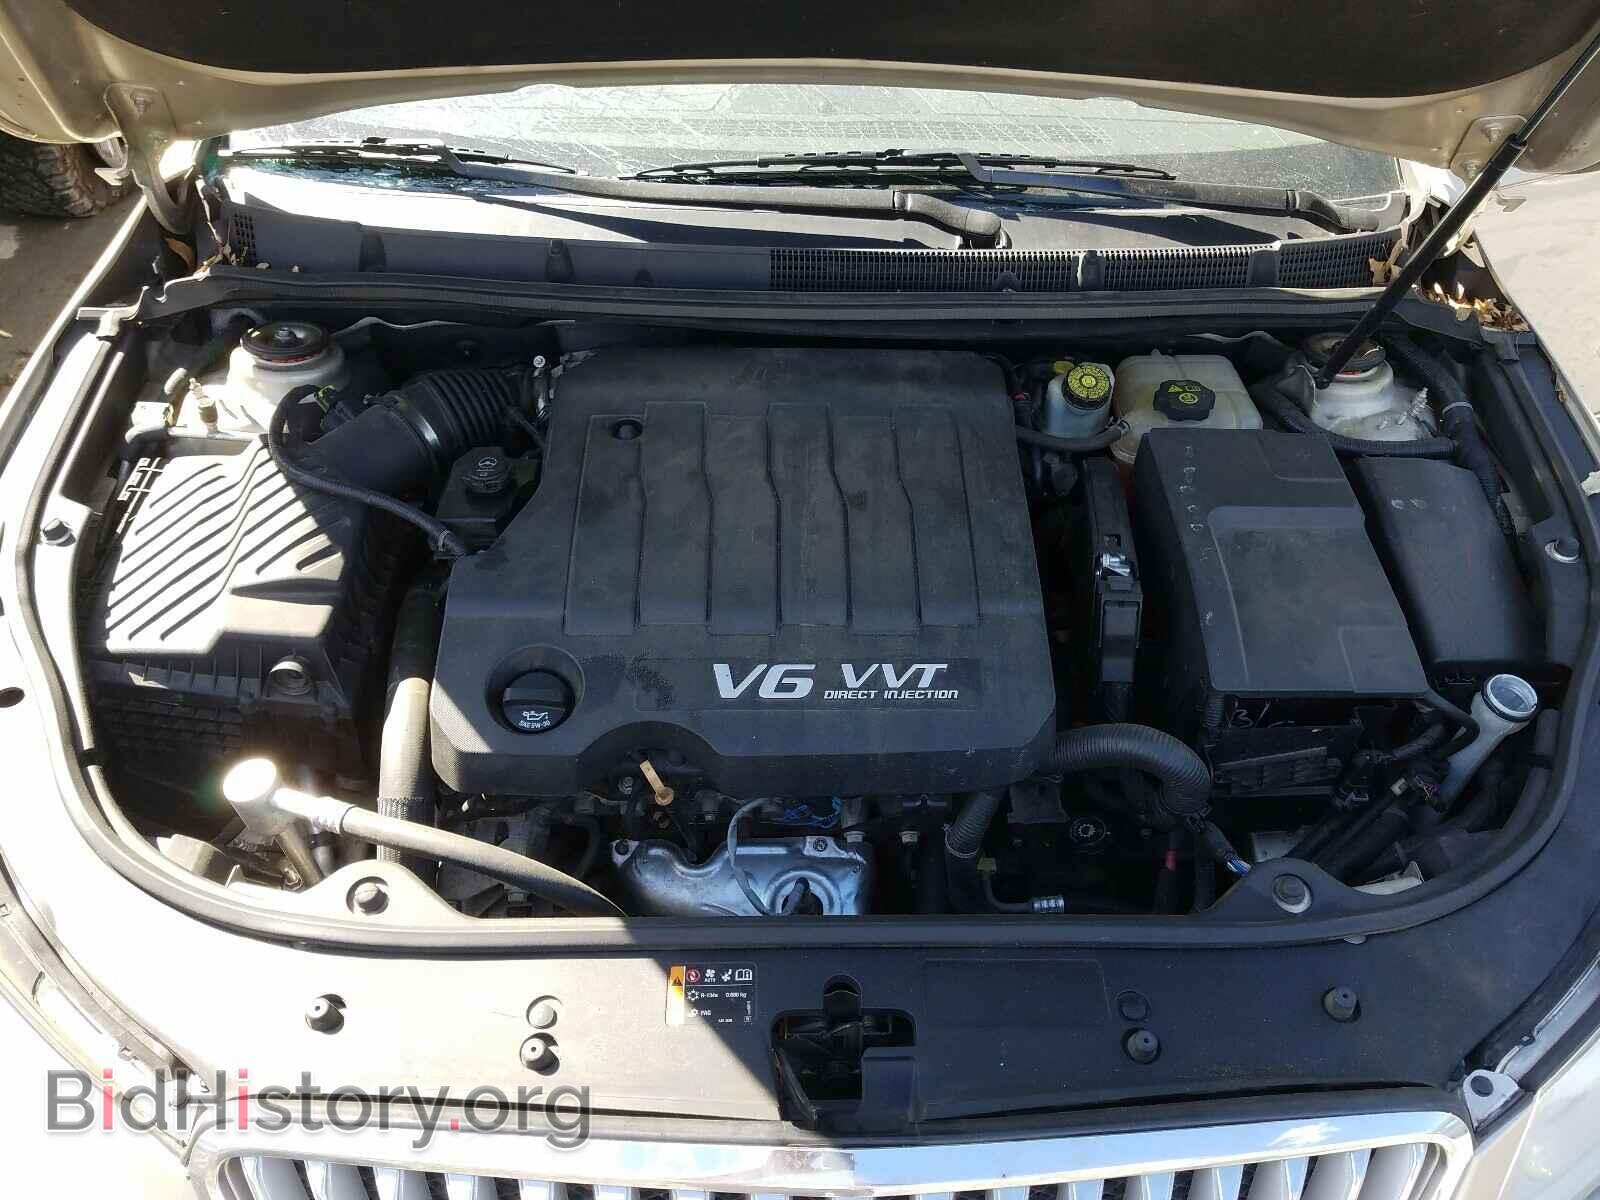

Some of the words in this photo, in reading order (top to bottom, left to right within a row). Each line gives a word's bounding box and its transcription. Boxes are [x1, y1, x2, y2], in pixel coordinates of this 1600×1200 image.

[713, 663, 816, 699] V6
[841, 663, 949, 688] VVT
[823, 690, 878, 699] DIRECT
[883, 690, 959, 699] INJECTION
